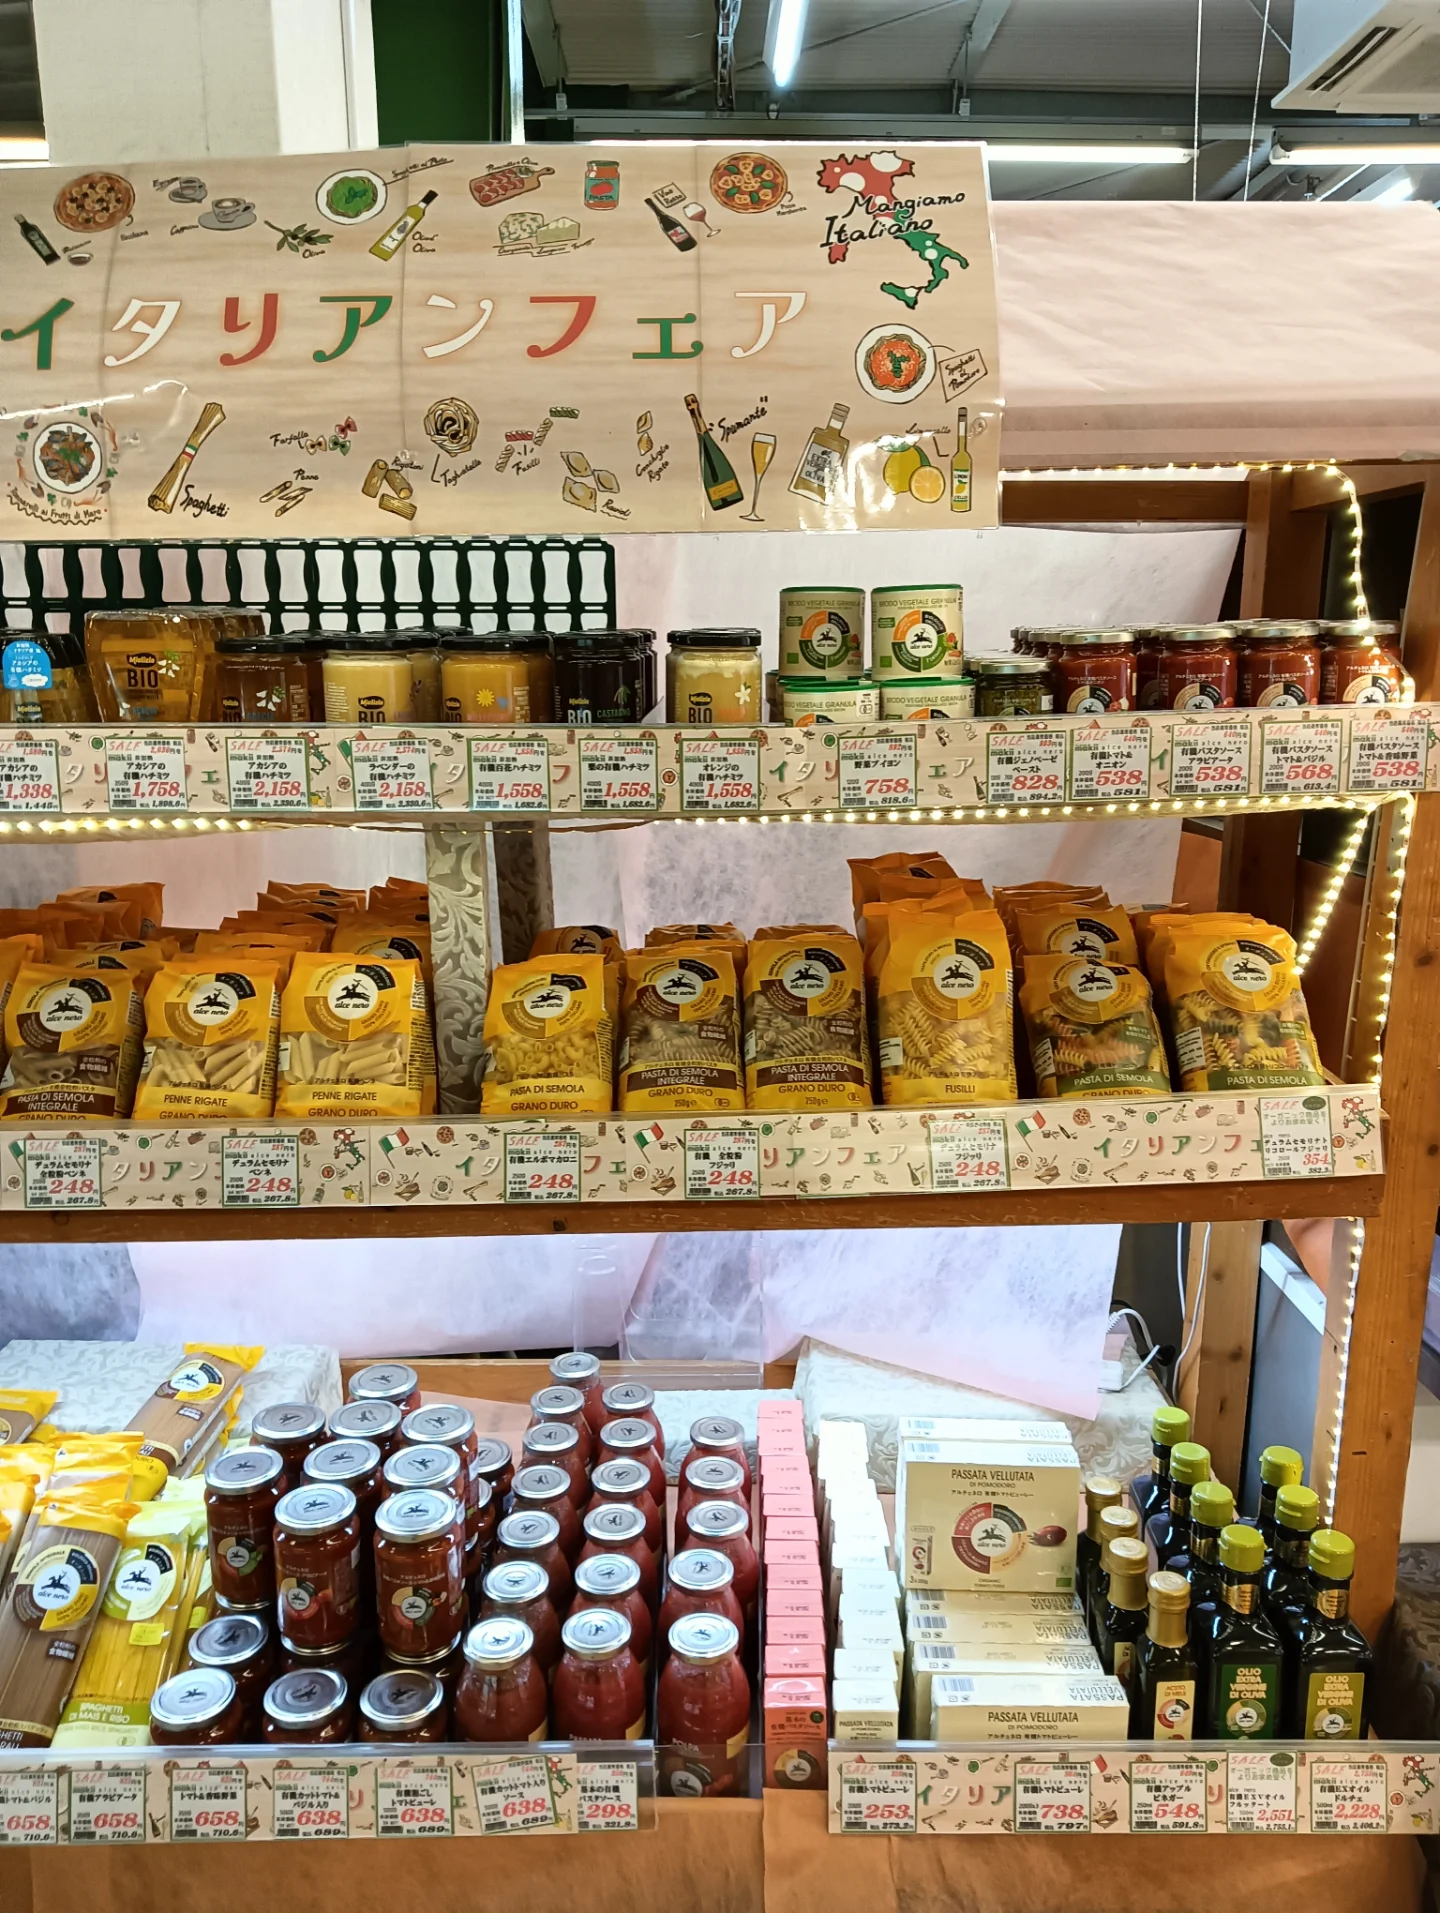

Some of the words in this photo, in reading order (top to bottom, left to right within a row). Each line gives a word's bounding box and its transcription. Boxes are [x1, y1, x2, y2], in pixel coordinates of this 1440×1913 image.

[842, 193, 965, 219] Mangiamo
[820, 215, 933, 248] Italiano
[1, 292, 807, 371] イタリアンフェア
[945, 353, 976, 376] Spaghetti
[512, 458, 540, 475] Fusilli
[180, 484, 230, 518] Spaghetti
[602, 498, 631, 517] Ravioli
[51, 508, 71, 519] Frutti
[84, 509, 101, 519] Mare
[127, 669, 158, 688] BIO
[1175, 726, 1209, 737] SALE
[1266, 725, 1299, 736] SALE
[1354, 722, 1387, 733] SALE
[992, 736, 1024, 746] SALE
[1076, 731, 1108, 741] SALE
[110, 742, 142, 751] SALE
[231, 741, 263, 750] SALE
[355, 742, 387, 752] SALE
[474, 743, 506, 752] SALE
[583, 742, 615, 752] SALE
[686, 743, 718, 752] SALE
[842, 740, 874, 750] SALE
[1272, 745, 1333, 755] 有機パスタソース
[1360, 742, 1419, 751] 有機パスタソース
[1181, 747, 1242, 756] 有機パスタソース
[854, 761, 901, 769] 野菜ブイヨン
[997, 755, 1058, 765] 有機ジェノベーゼ
[1095, 761, 1126, 769] オニオン
[1188, 757, 1233, 765] アラビアータ
[248, 762, 287, 770] アカシアの
[369, 763, 415, 771] ラベンダーの
[479, 764, 542, 772] 有機百花ハチミツ
[588, 763, 650, 771] 栗の有機ハチミツ
[703, 763, 739, 771] オレンジの
[1012, 766, 1041, 774] ペースト
[123, 772, 170, 780] 有機ハチミツ
[245, 772, 291, 780] 有機ハチミツ
[370, 772, 415, 780] 有機ハチミツ
[698, 773, 743, 781] 有機ハチミツ
[335, 1001, 350, 1009] alce
[46, 1014, 62, 1022] alce
[641, 1070, 668, 1080] PASTA
[669, 1068, 680, 1076] DI
[681, 1068, 719, 1078] SEMOLA
[771, 1066, 798, 1075] PASTA
[799, 1064, 809, 1072] DI
[810, 1063, 849, 1072] SEMOLA
[657, 1076, 705, 1085] INTEGRALE
[787, 1071, 836, 1081] INTEGRALE
[1073, 1076, 1101, 1086] PASTA
[1104, 1074, 1114, 1082] DI
[1116, 1073, 1154, 1083] SEMOLA
[1227, 1076, 1256, 1085] PASTA
[1258, 1075, 1267, 1084] DI
[1269, 1075, 1308, 1085] SEMOLA
[509, 1087, 531, 1097] PASTA
[534, 1085, 544, 1093] DI
[546, 1084, 585, 1093] SEMOLA
[648, 1086, 684, 1098] GRANO
[686, 1086, 713, 1097] DURO
[778, 1084, 815, 1094] GRANO
[817, 1083, 846, 1093] DURO
[945, 1084, 976, 1094] FUSILLI
[18, 1094, 39, 1103] PASTA
[41, 1092, 50, 1100] DI
[52, 1092, 95, 1103] SEMOLA
[164, 1094, 192, 1105] PENNE
[194, 1096, 228, 1107] RIGATE
[312, 1091, 342, 1101] PENNE
[344, 1091, 377, 1101] RIGATE
[28, 1102, 78, 1112] INTEGRALE
[510, 1101, 548, 1111] GRANO
[549, 1101, 578, 1110] DURO
[307, 1107, 346, 1118] GRANO
[508, 1156, 578, 1164] 有機エルボマカロニ
[955, 1152, 981, 1160] フジッリ
[35, 1161, 92, 1169] デュラムセモリナ
[709, 1161, 735, 1169] フジッリ
[249, 1168, 271, 1176] ペンネ
[951, 1470, 988, 1481] PASSATA
[990, 1470, 1035, 1482] VELLUTATA
[1237, 1667, 1261, 1675] OLIO
[1325, 1675, 1349, 1683] OLIO
[1230, 1691, 1239, 1699] DI
[1241, 1691, 1266, 1699] OLIVA
[80, 1702, 123, 1713] SPAGHETTI
[988, 1711, 1027, 1722] PASSATA
[1031, 1711, 1079, 1722] VELLUTATA
[1146, 1785, 1192, 1793] 有機アップル
[79, 1793, 137, 1802] 有機アラビアータ
[503, 1792, 524, 1800] ソース
[1153, 1794, 1184, 1802] ビネガー
[1334, 1794, 1363, 1802] ドルチェ
